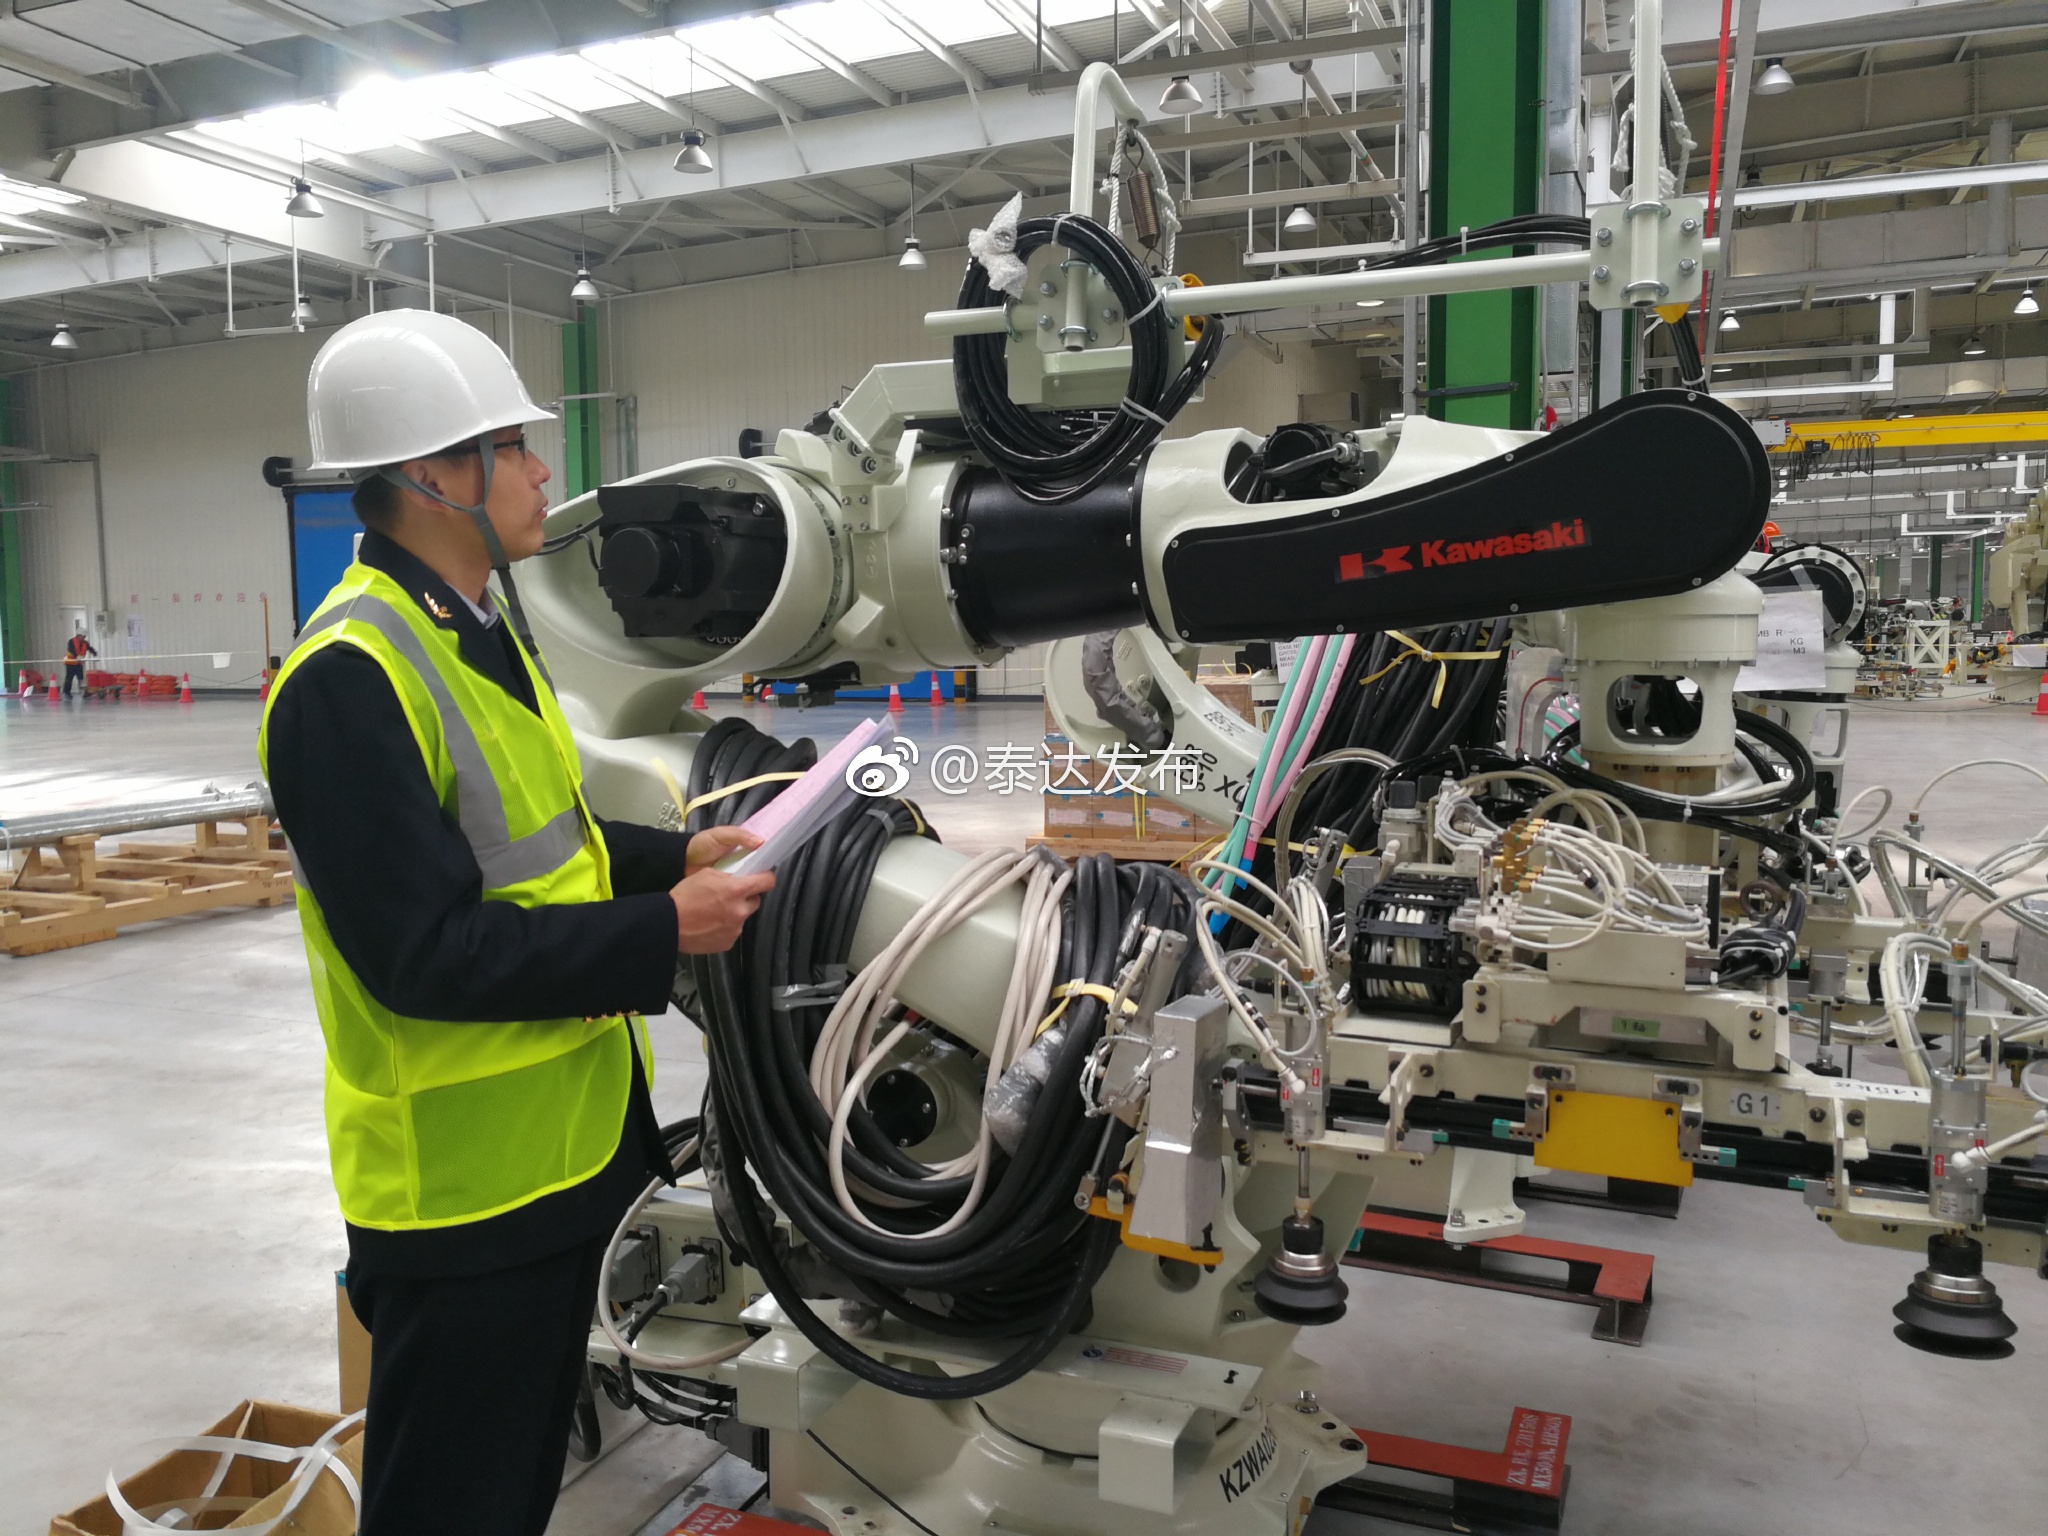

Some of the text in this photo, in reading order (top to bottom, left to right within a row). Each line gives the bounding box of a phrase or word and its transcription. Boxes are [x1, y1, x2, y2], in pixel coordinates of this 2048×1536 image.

[1421, 518, 1585, 568] Kawasaki
[1790, 637, 1804, 646] KG
[1736, 1093, 1769, 1117] G1
